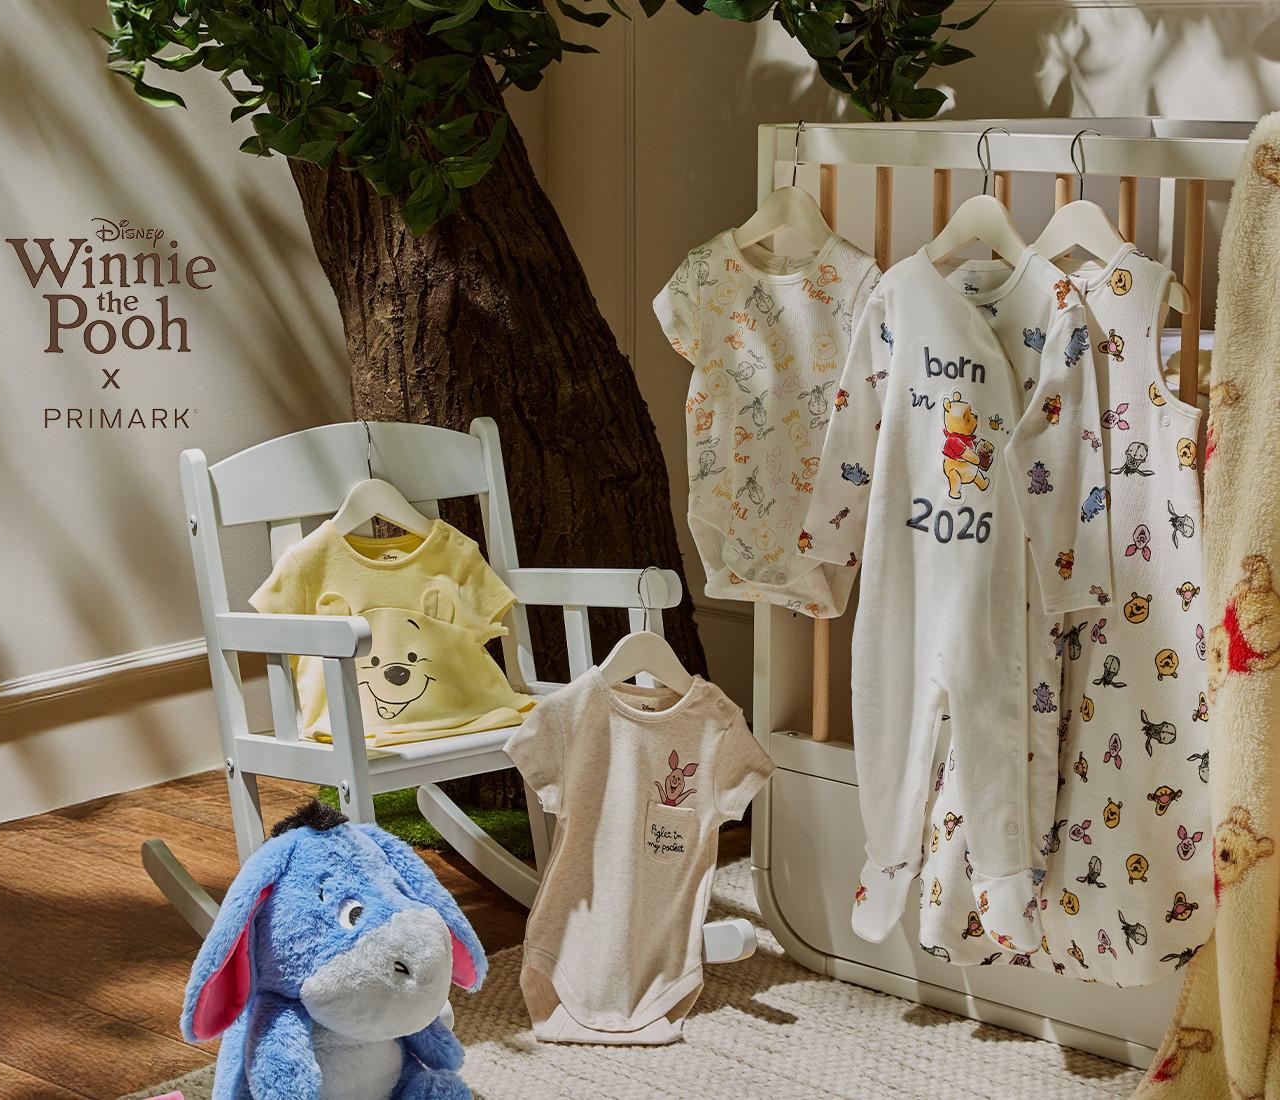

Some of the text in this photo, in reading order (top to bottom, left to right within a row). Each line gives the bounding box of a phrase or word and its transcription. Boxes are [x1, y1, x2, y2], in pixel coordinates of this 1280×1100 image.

[801, 277, 834, 305] Tigger
[923, 346, 986, 384] born
[908, 387, 936, 410] in
[906, 498, 993, 544] 2026
[647, 841, 661, 855] my
[673, 830, 684, 841] in
